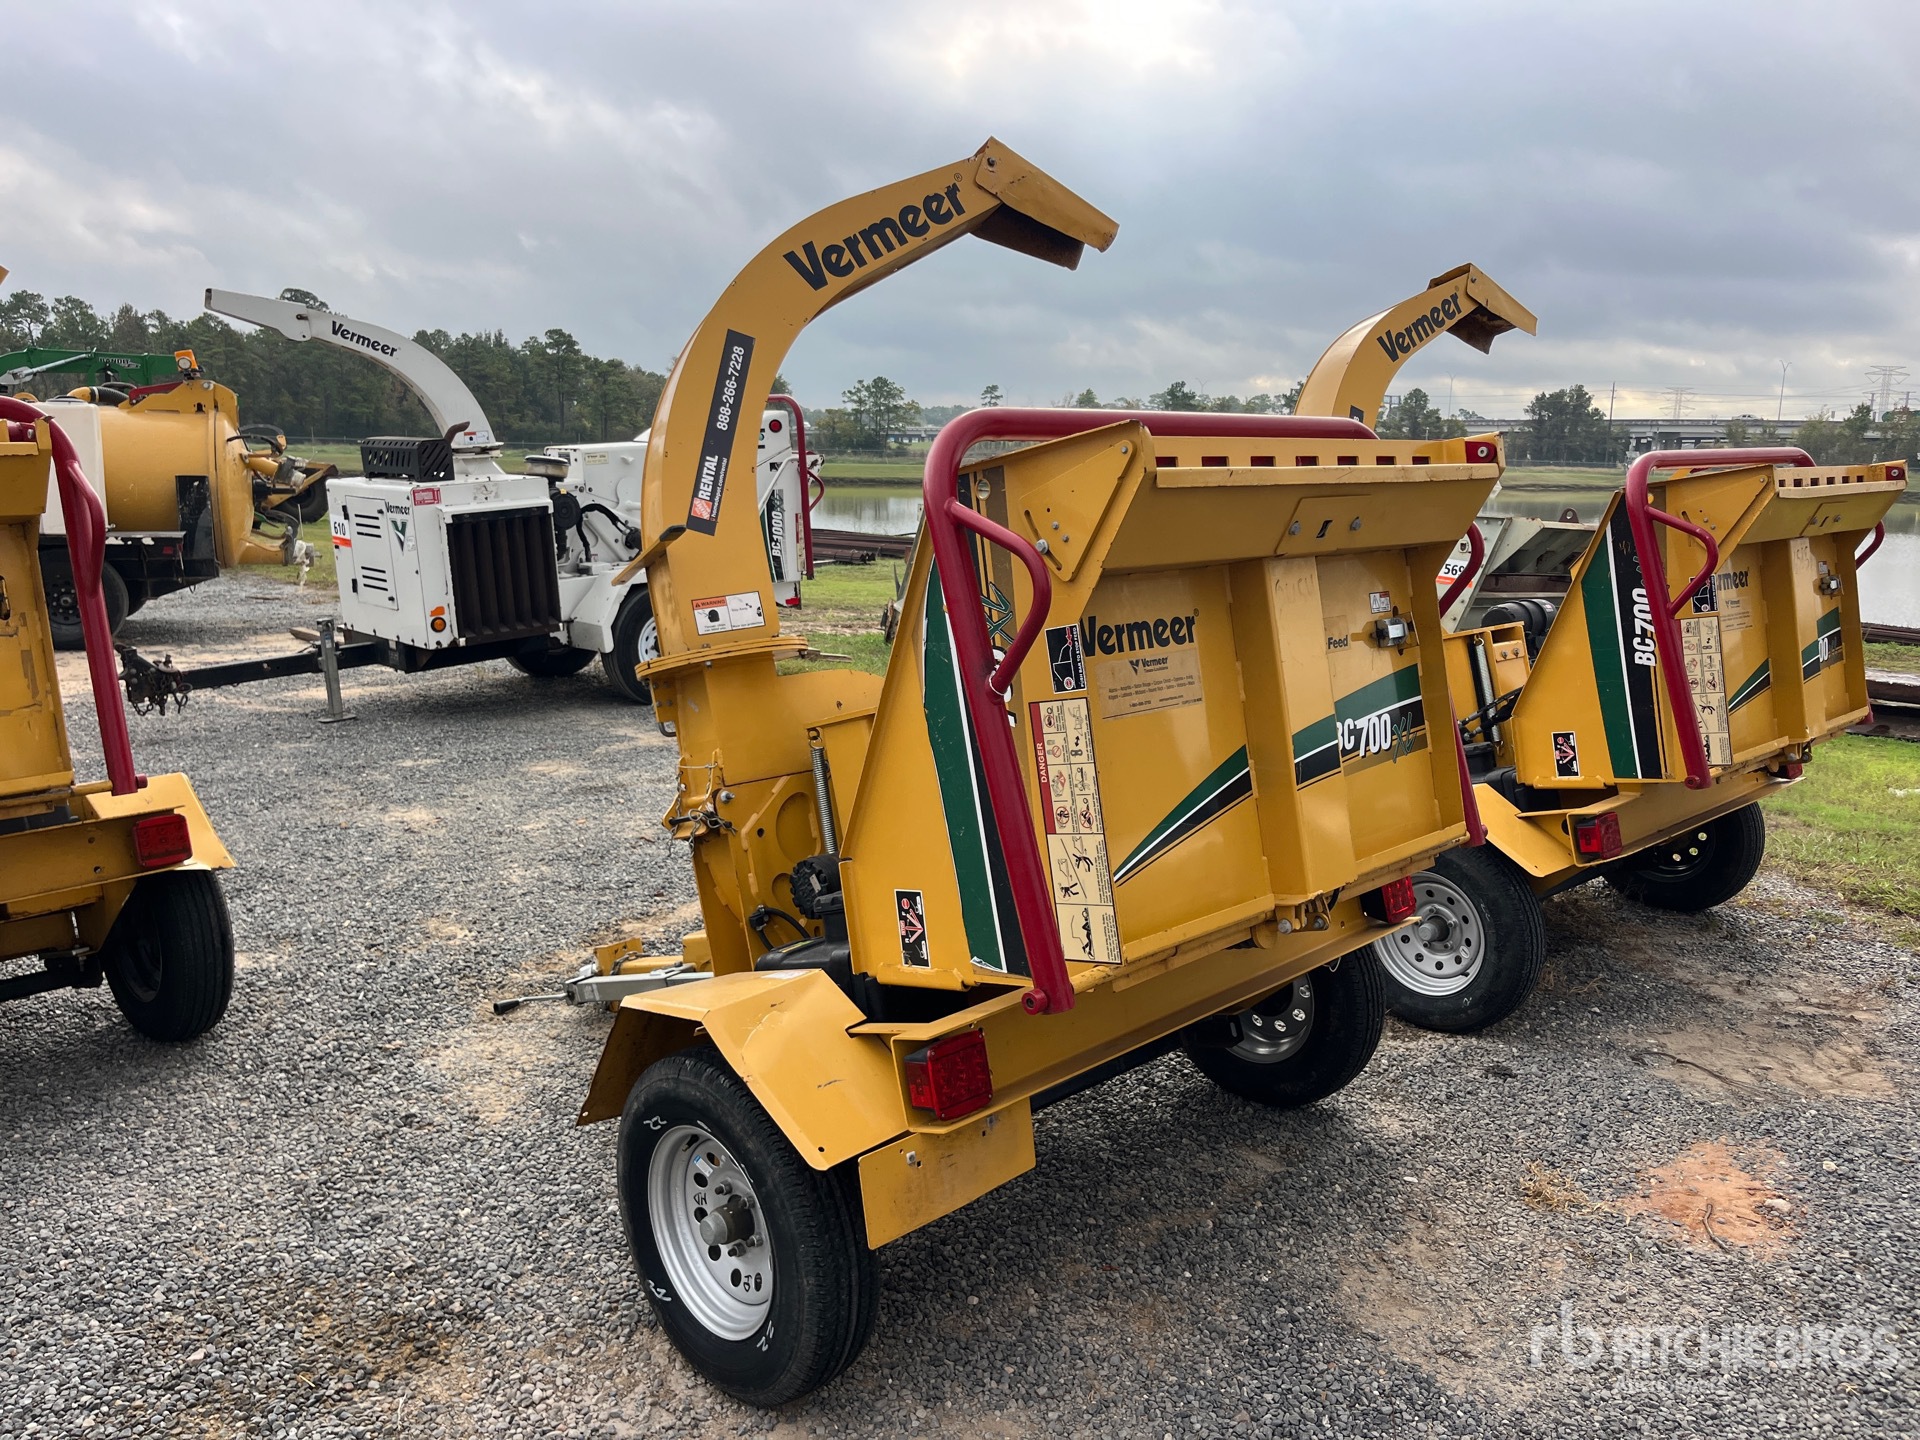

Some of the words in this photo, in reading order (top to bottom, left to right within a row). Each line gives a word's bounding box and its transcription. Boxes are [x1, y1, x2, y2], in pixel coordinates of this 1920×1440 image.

[783, 183, 966, 291] Vermeer
[332, 320, 397, 357] Vermeer
[1376, 292, 1462, 362] Vermeer
[716, 345, 744, 431] 888-266-7228
[698, 455, 719, 501] RENTAL
[333, 521, 346, 536] 610
[385, 501, 410, 515] Vermeer
[1718, 570, 1749, 591] rmeer
[1080, 615, 1196, 658] Vermeer
[1327, 635, 1348, 650] Feed
[1036, 742, 1048, 783] DANGER
